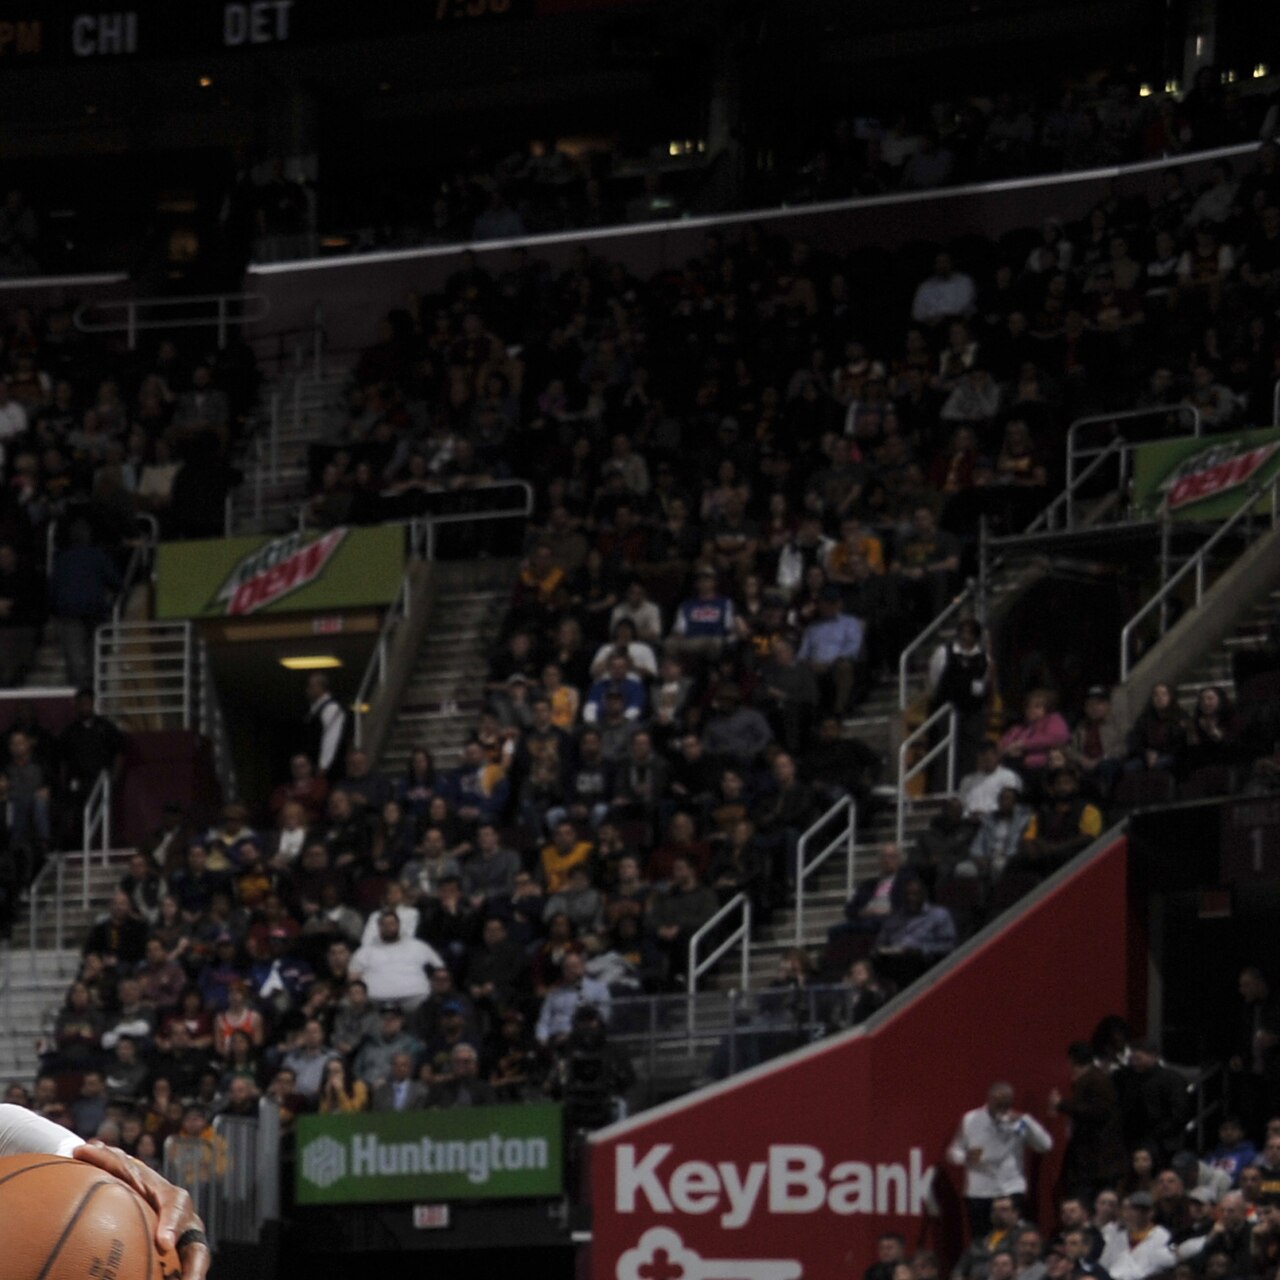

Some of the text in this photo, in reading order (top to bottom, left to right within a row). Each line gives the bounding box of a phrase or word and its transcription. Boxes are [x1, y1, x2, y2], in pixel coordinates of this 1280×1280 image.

[72, 11, 139, 57] CHI
[222, 0, 292, 47] DET
[351, 1132, 548, 1184] Huntington
[614, 1142, 940, 1230] KeyBank
